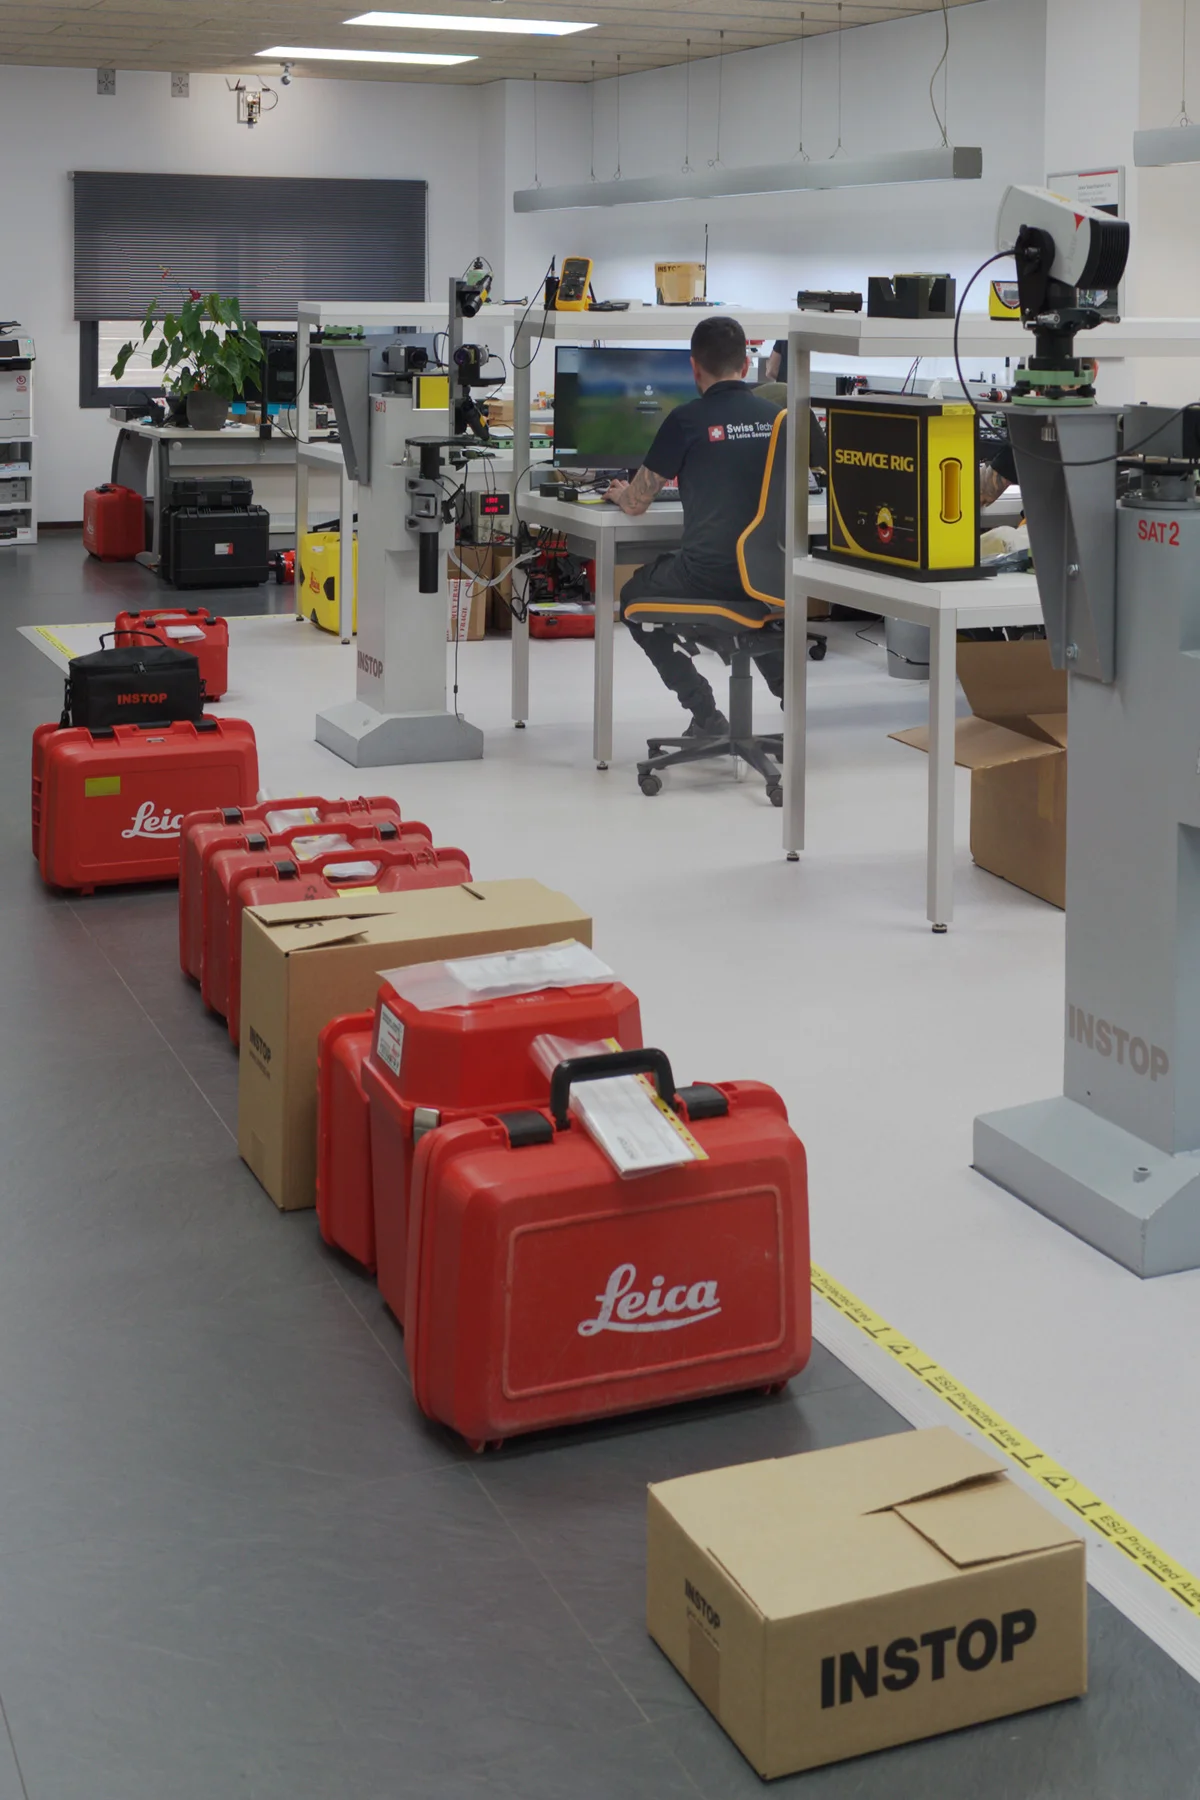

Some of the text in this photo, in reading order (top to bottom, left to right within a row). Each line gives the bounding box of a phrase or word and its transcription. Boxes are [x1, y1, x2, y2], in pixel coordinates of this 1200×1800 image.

[726, 423, 754, 433] Swiss
[835, 449, 914, 472] SERVICE RIG
[357, 650, 384, 679] INSTOP
[117, 692, 168, 705] INSTOP
[121, 801, 185, 839] Leic
[1069, 1004, 1169, 1081] INSTOP
[578, 1263, 722, 1337] Leica
[820, 1278, 872, 1321] Protected Area
[934, 1376, 1021, 1447] ESD Protected Area
[1100, 1515, 1128, 1535] ESD
[1126, 1535, 1182, 1580] Protected
[684, 1578, 721, 1630] INSTOP
[820, 1608, 1037, 1709] INSTOP
